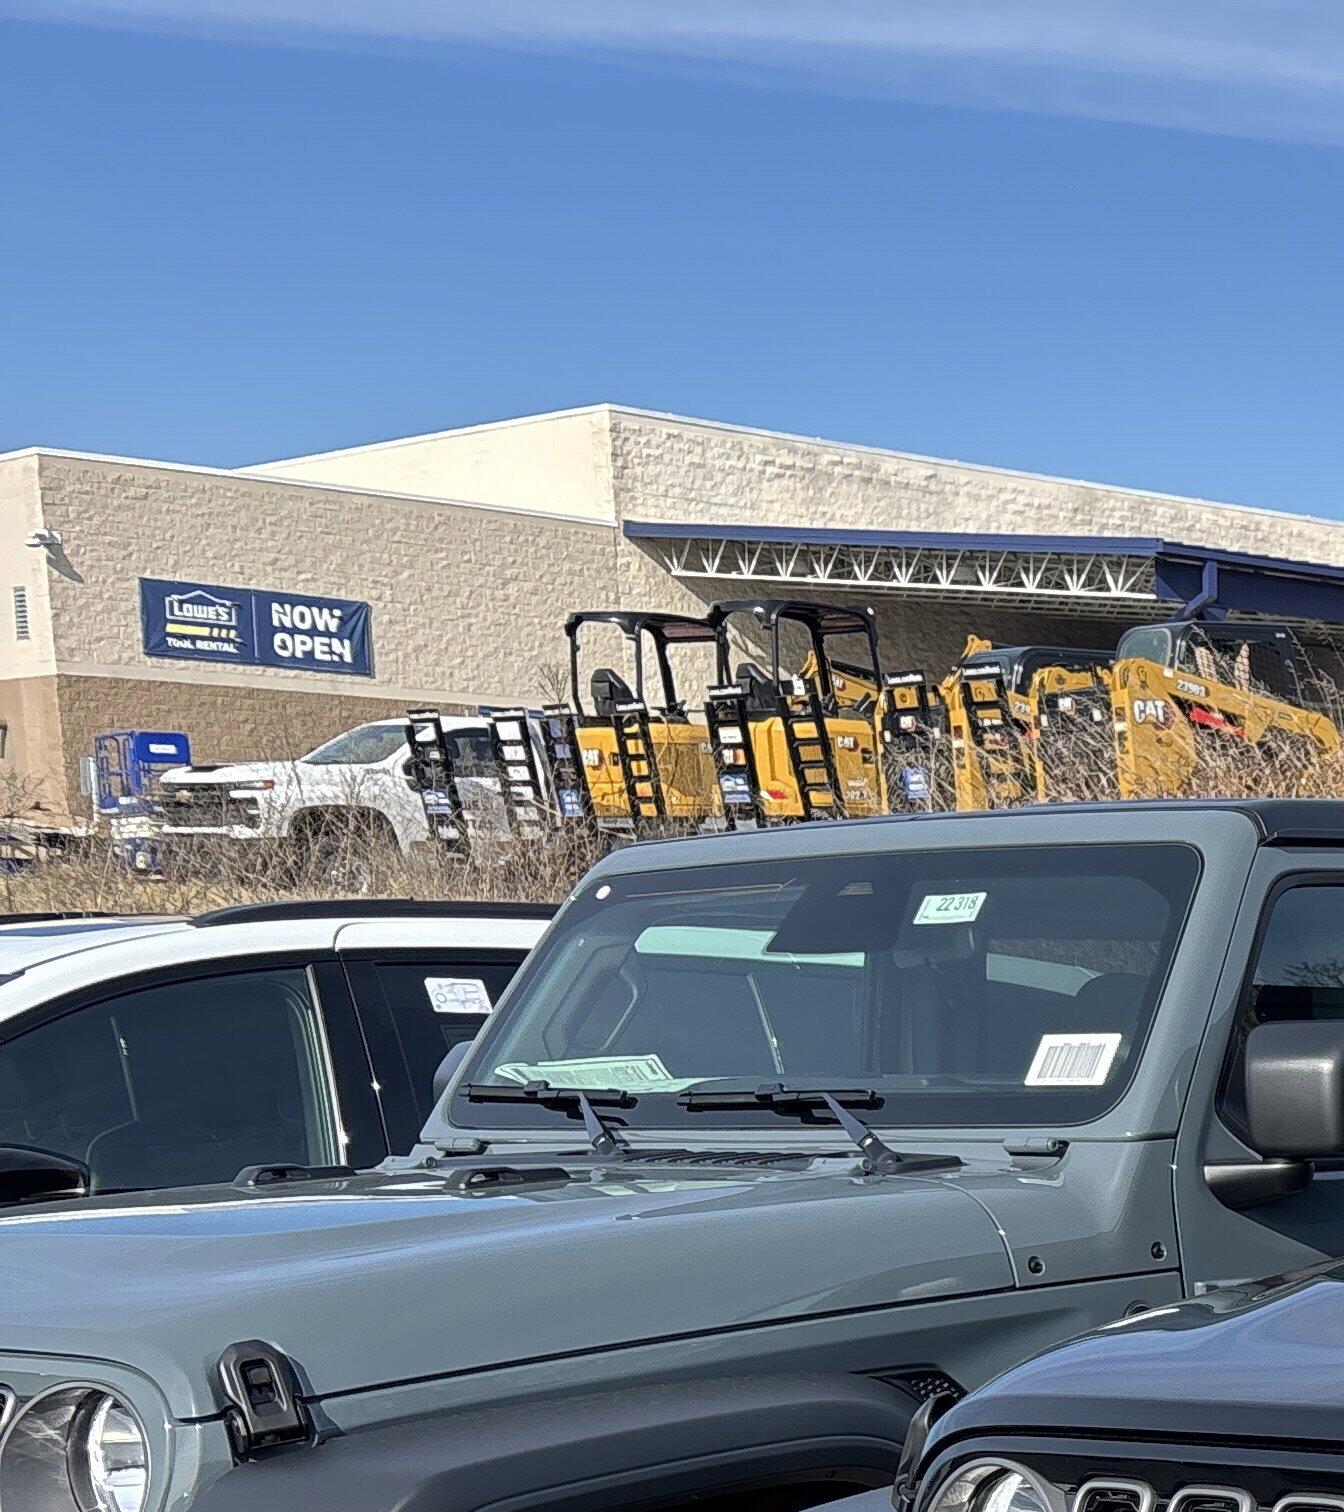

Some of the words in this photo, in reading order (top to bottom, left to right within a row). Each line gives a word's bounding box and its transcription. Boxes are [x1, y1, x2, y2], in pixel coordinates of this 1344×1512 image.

[173, 603, 230, 621] LOWE'S
[271, 602, 342, 632] NOW
[196, 639, 240, 654] RENTAL
[273, 632, 354, 663] OPEN
[1133, 699, 1166, 724] CAT
